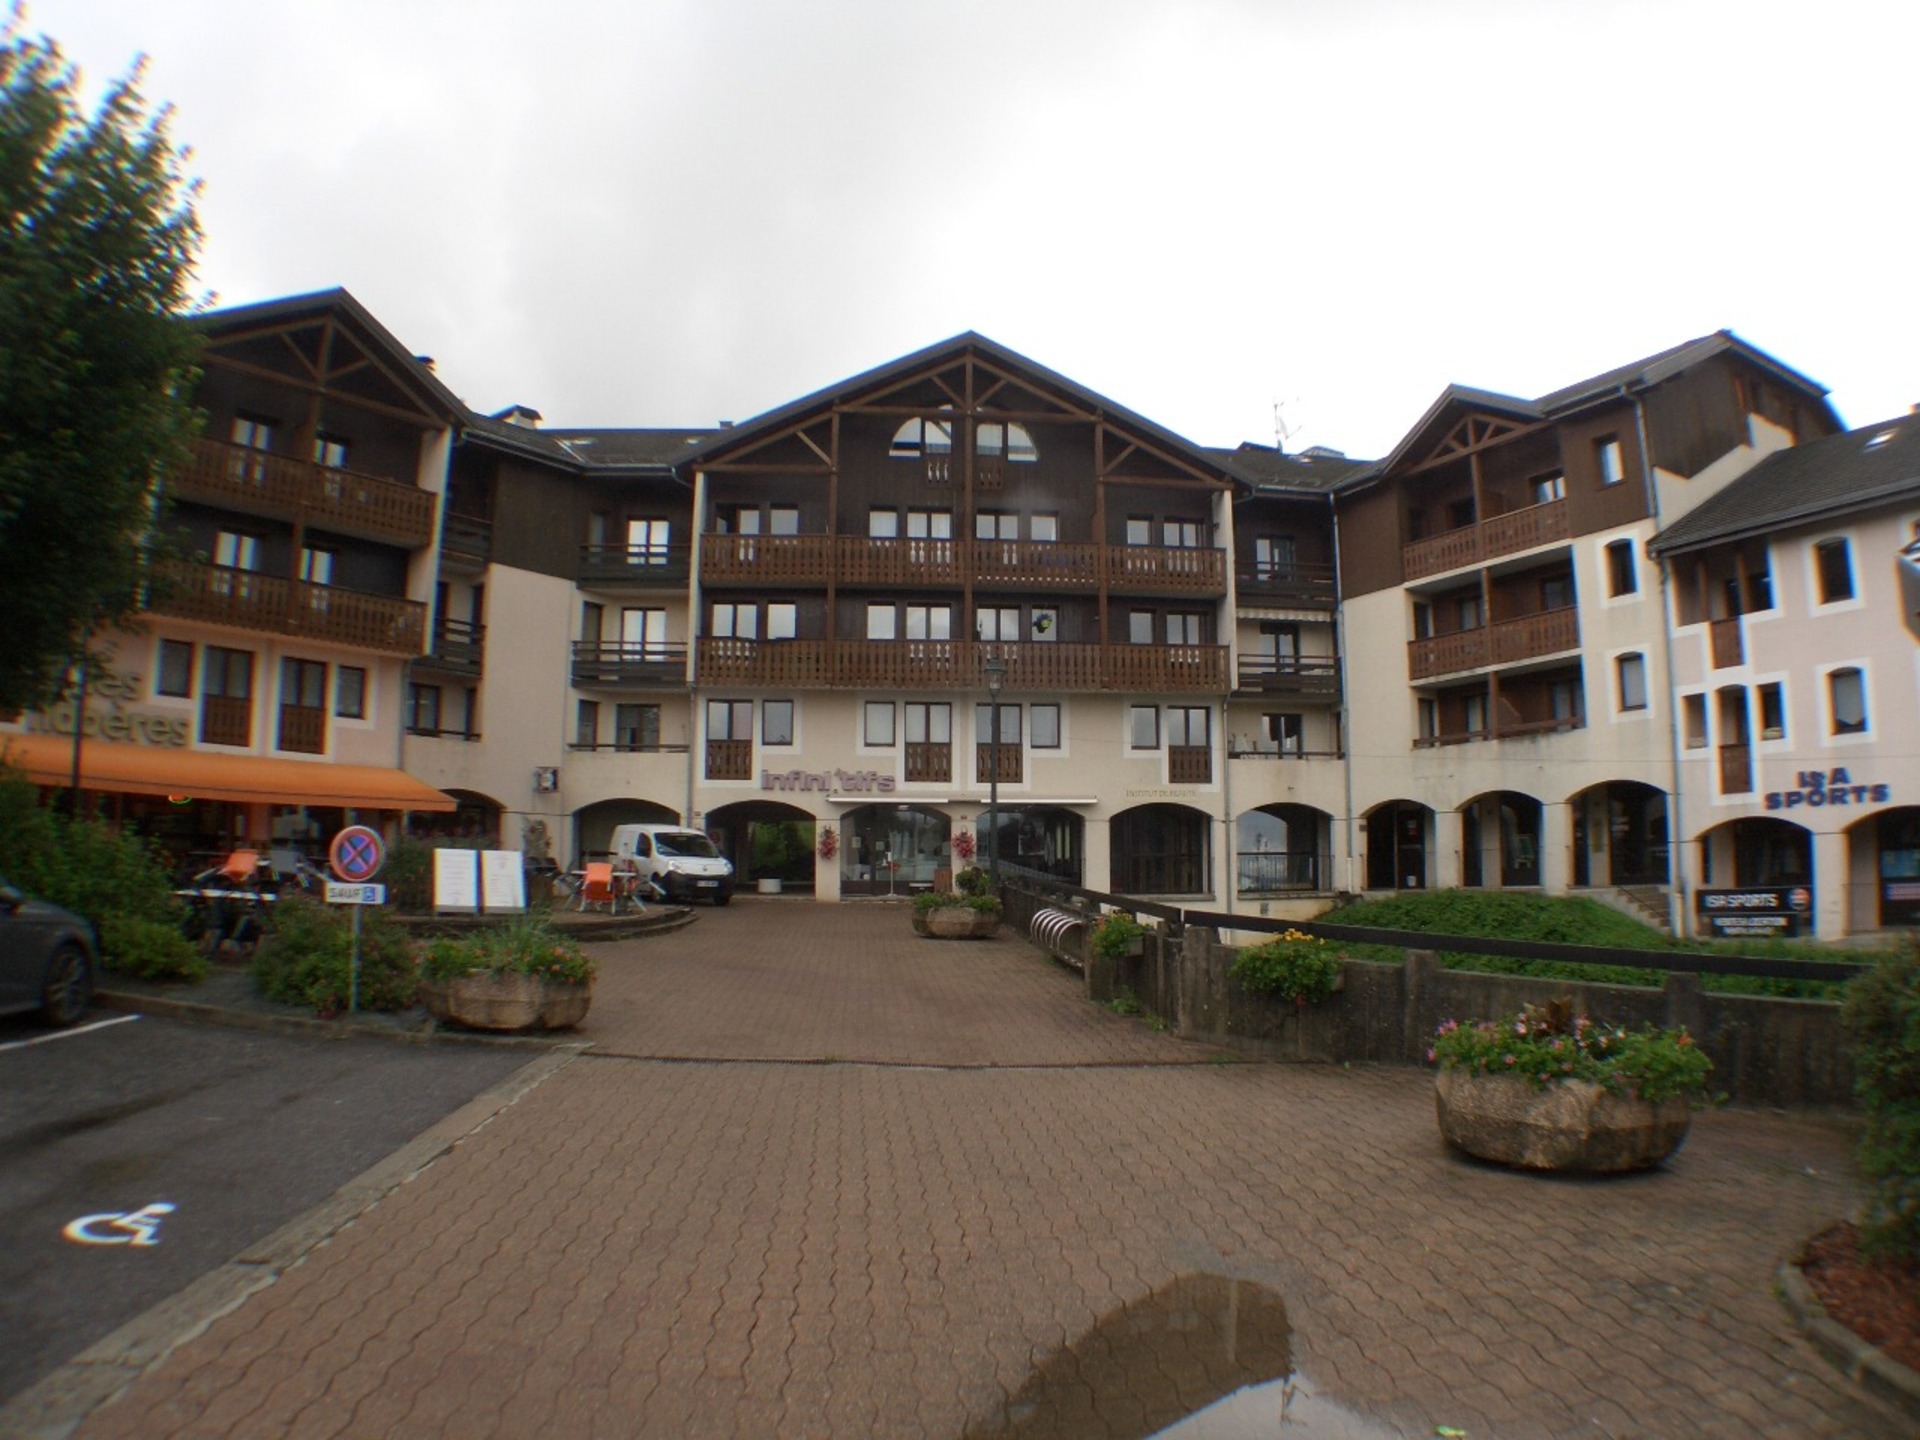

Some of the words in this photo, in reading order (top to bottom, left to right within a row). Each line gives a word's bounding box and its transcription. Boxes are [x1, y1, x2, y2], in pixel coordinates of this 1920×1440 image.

[1796, 767, 1850, 789] ISA
[1764, 784, 1889, 811] SPORTS
[330, 887, 361, 899] SAUF
[1704, 895, 1727, 908] ISA
[1728, 894, 1778, 908] SPORTS
